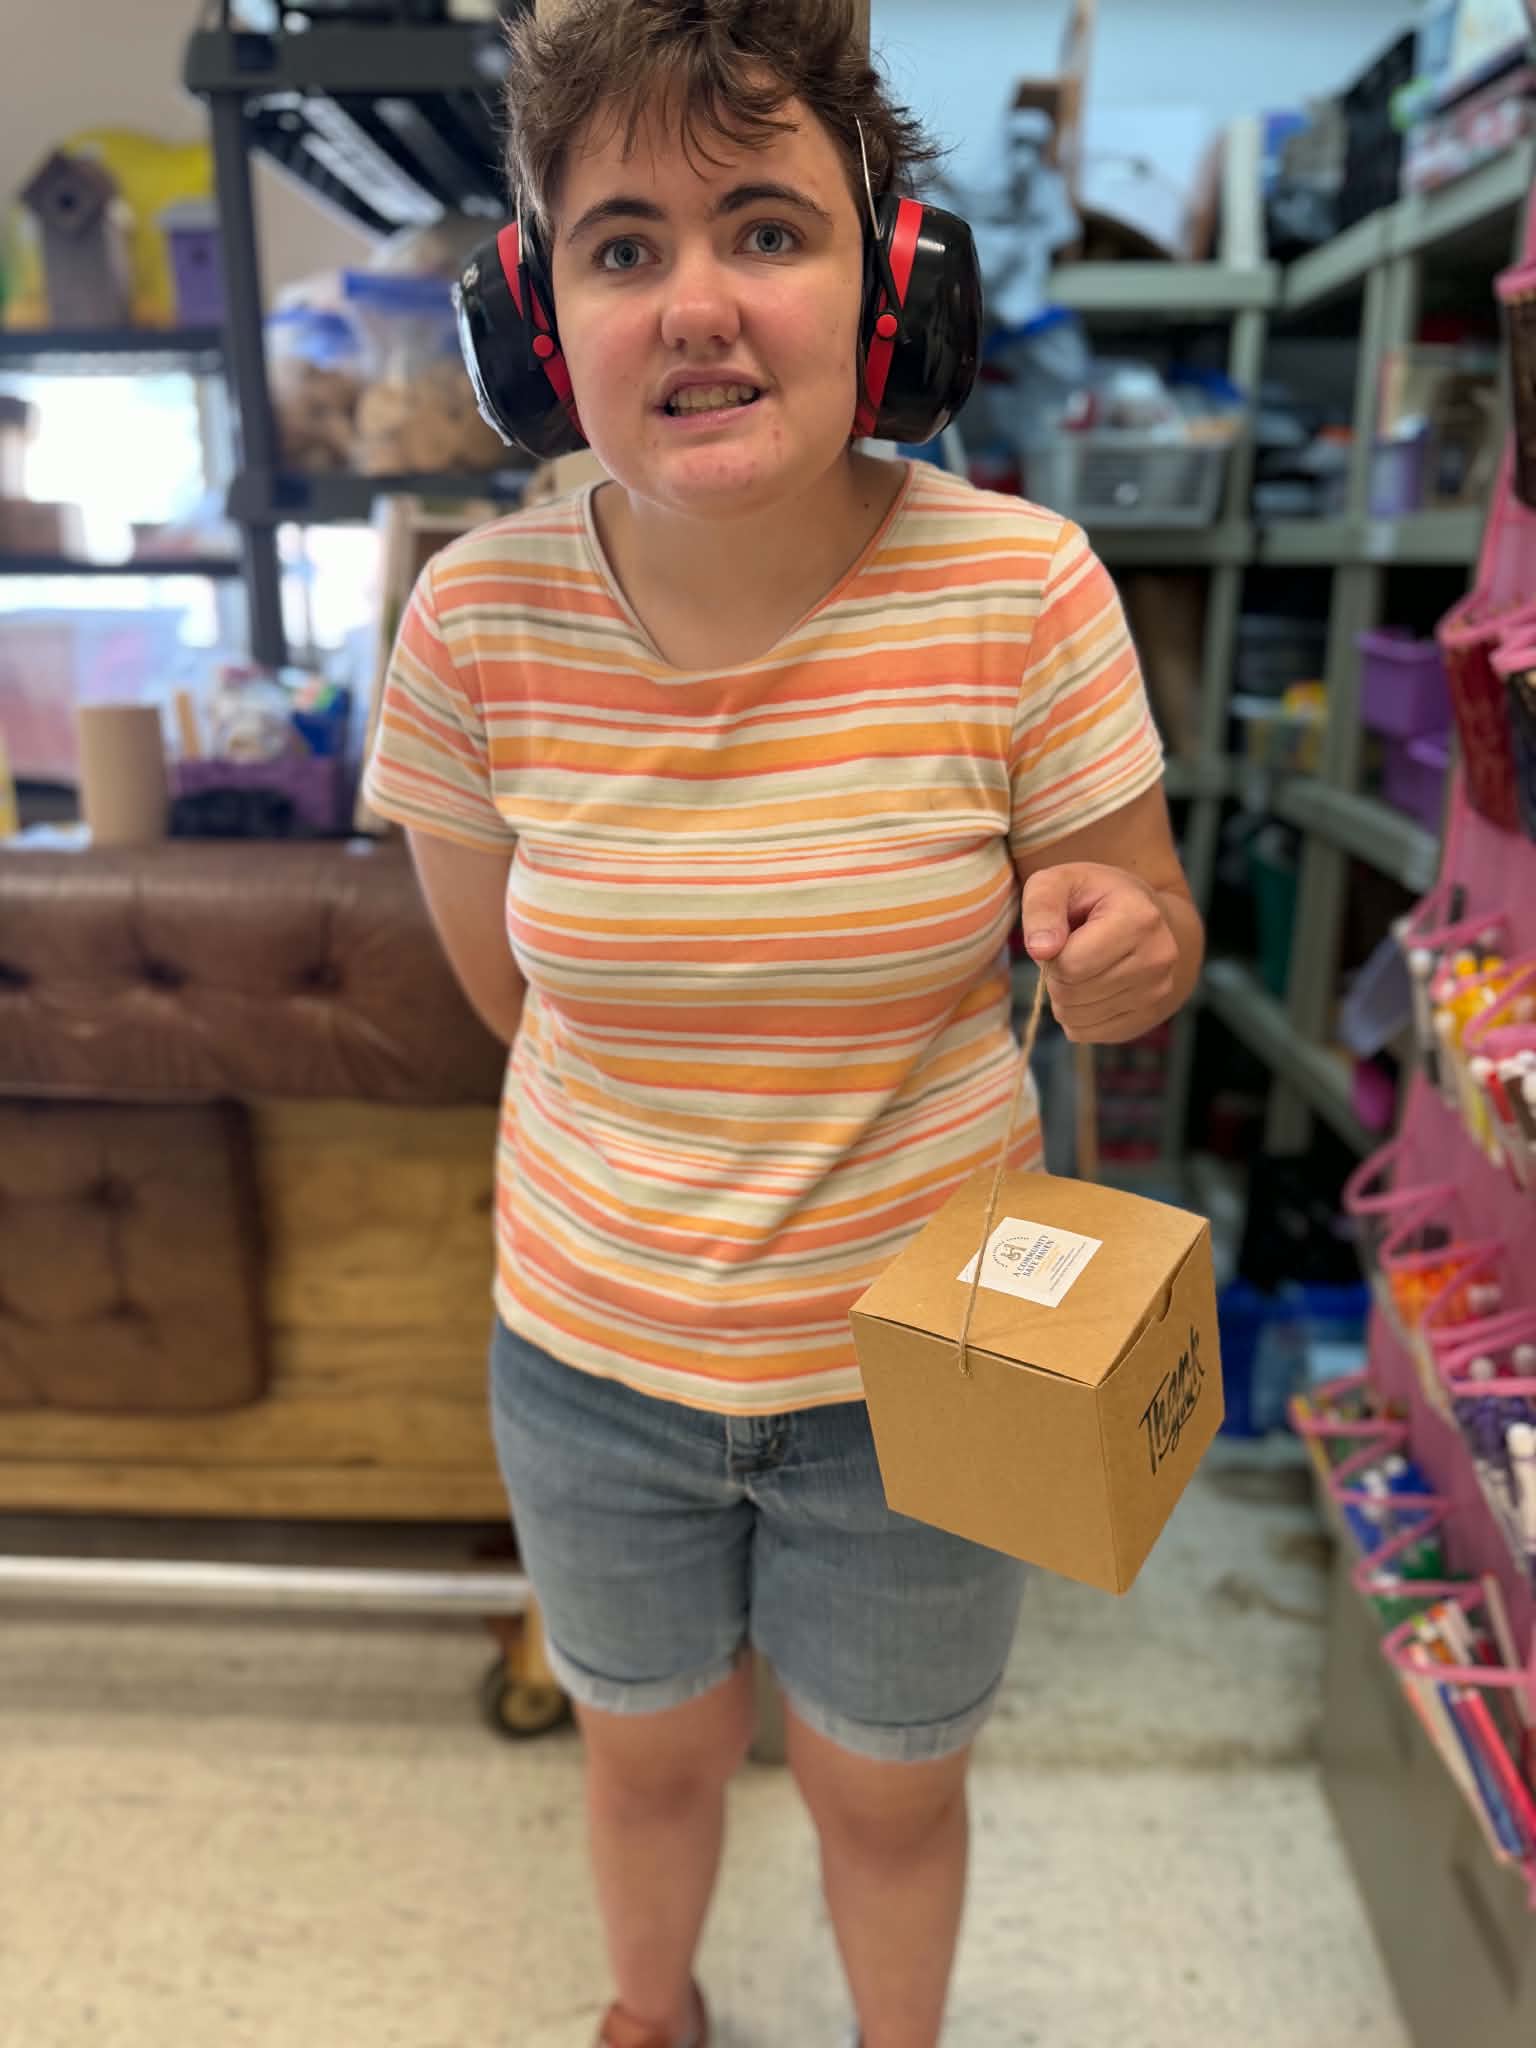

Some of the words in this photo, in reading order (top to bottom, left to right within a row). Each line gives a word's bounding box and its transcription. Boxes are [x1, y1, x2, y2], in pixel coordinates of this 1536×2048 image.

[1017, 1235, 1048, 1271] COMMUNITY
[1022, 1260, 1040, 1276] SAFE
[1034, 1239, 1055, 1260] HAVEN
